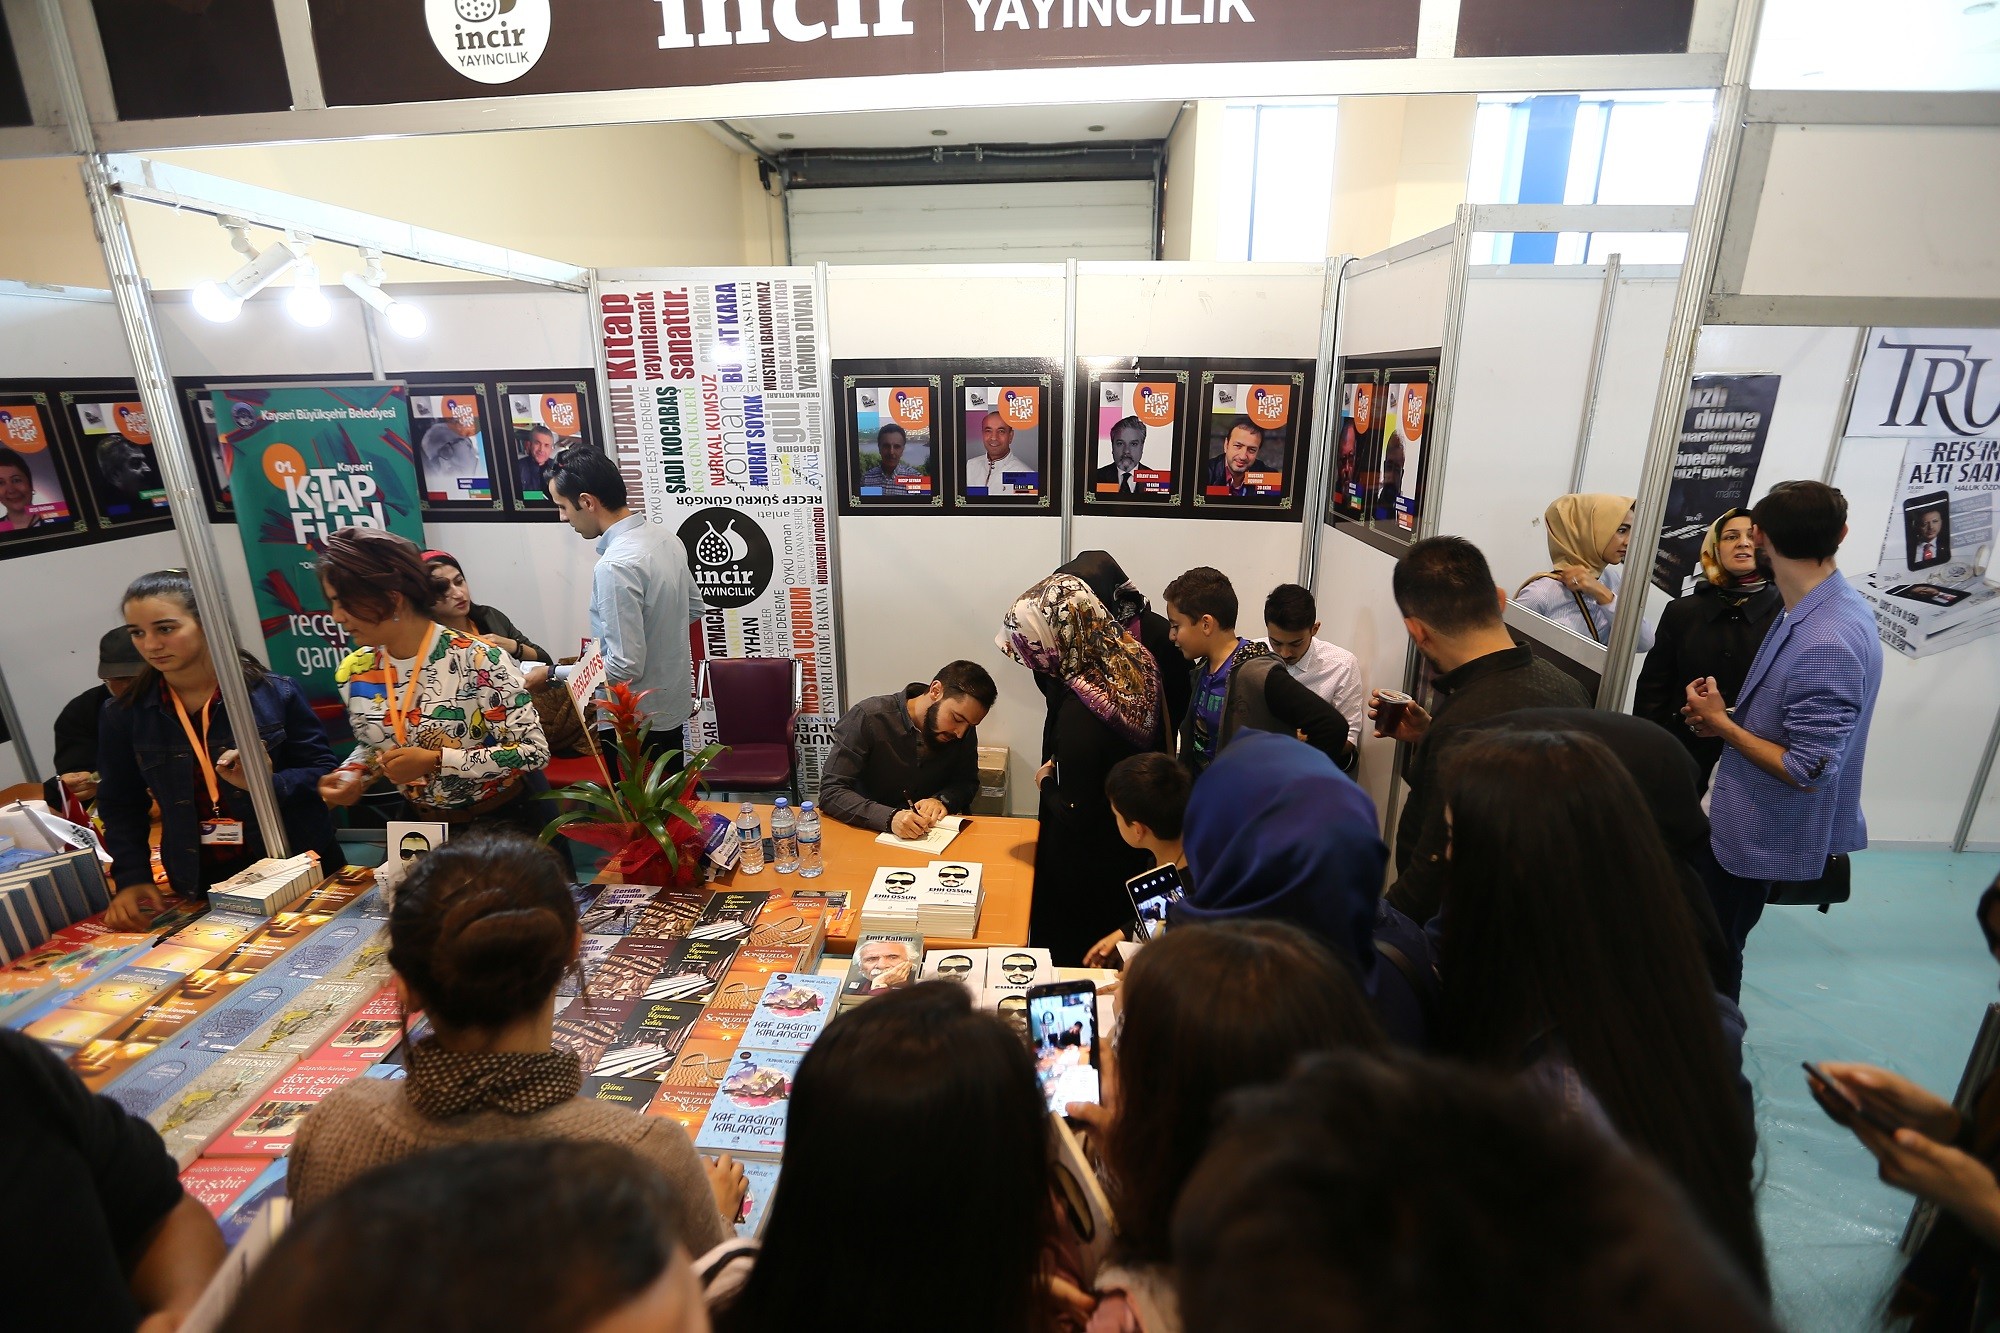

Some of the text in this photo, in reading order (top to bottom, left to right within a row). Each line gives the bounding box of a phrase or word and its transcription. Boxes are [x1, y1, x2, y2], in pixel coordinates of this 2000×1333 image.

[455, 21, 525, 50] incir
[458, 51, 530, 67] YAYINCILIK
[693, 286, 712, 330] kalkan
[715, 283, 738, 324] KARA
[739, 282, 751, 306] VELİ
[601, 294, 637, 379] Kitap
[634, 292, 663, 380] yayınlamak
[662, 287, 695, 379] sanattır.
[757, 282, 777, 390] MUSTAFA İBAKORKMAZ
[774, 280, 793, 390] GERİDE KALANLAR KİTABI
[791, 285, 817, 390] YAĞMUR DİVANI
[260, 407, 396, 422] Kayseri Büyükşehir Belediyesi
[639, 387, 653, 429] DENEME
[765, 402, 806, 443] gül
[1694, 409, 1761, 431] dünya
[656, 386, 690, 493] ŞADİ KOCABAŞ
[681, 388, 705, 493] KUŞ GÜNLÜKLERİ
[701, 374, 725, 486] NURKAL KUMSUZ
[720, 396, 747, 484] roman
[743, 395, 768, 486] MURAT SOYAK
[643, 433, 658, 473] ELEŞTİRİ
[776, 445, 820, 453] deneme
[274, 460, 373, 474] 01. Kayseri
[1910, 464, 1954, 484] ALTI
[676, 494, 822, 507] RECEP ŞÜKRÜ GÜNGÖR
[758, 511, 790, 519] anlatı
[781, 524, 795, 585] ÖYKÜ roman
[796, 531, 805, 562] UYANAN
[812, 507, 828, 584] HÜDAVERDİ AYDOĞDU
[695, 564, 754, 584] incir
[774, 590, 787, 628] DENEME
[790, 588, 818, 648] UÇURUM
[817, 588, 830, 632] BAKMA
[706, 608, 727, 657] ATMACA
[762, 609, 773, 644] RESİMLER
[804, 747, 819, 779] DAMLA
[362, 1006, 392, 1015] dört
[647, 1011, 680, 1020] Uyanan
[754, 1021, 774, 1029] KAF
[274, 1084, 303, 1095] dört
[283, 1074, 350, 1086] dört şehir
[596, 1090, 633, 1102] Uyanan
[600, 1082, 625, 1091] Güne
[678, 1104, 700, 1112] SÖZ
[712, 1112, 733, 1122] KAF
[713, 1123, 775, 1136] KIRLANGICI
[206, 1176, 247, 1190] şehir
